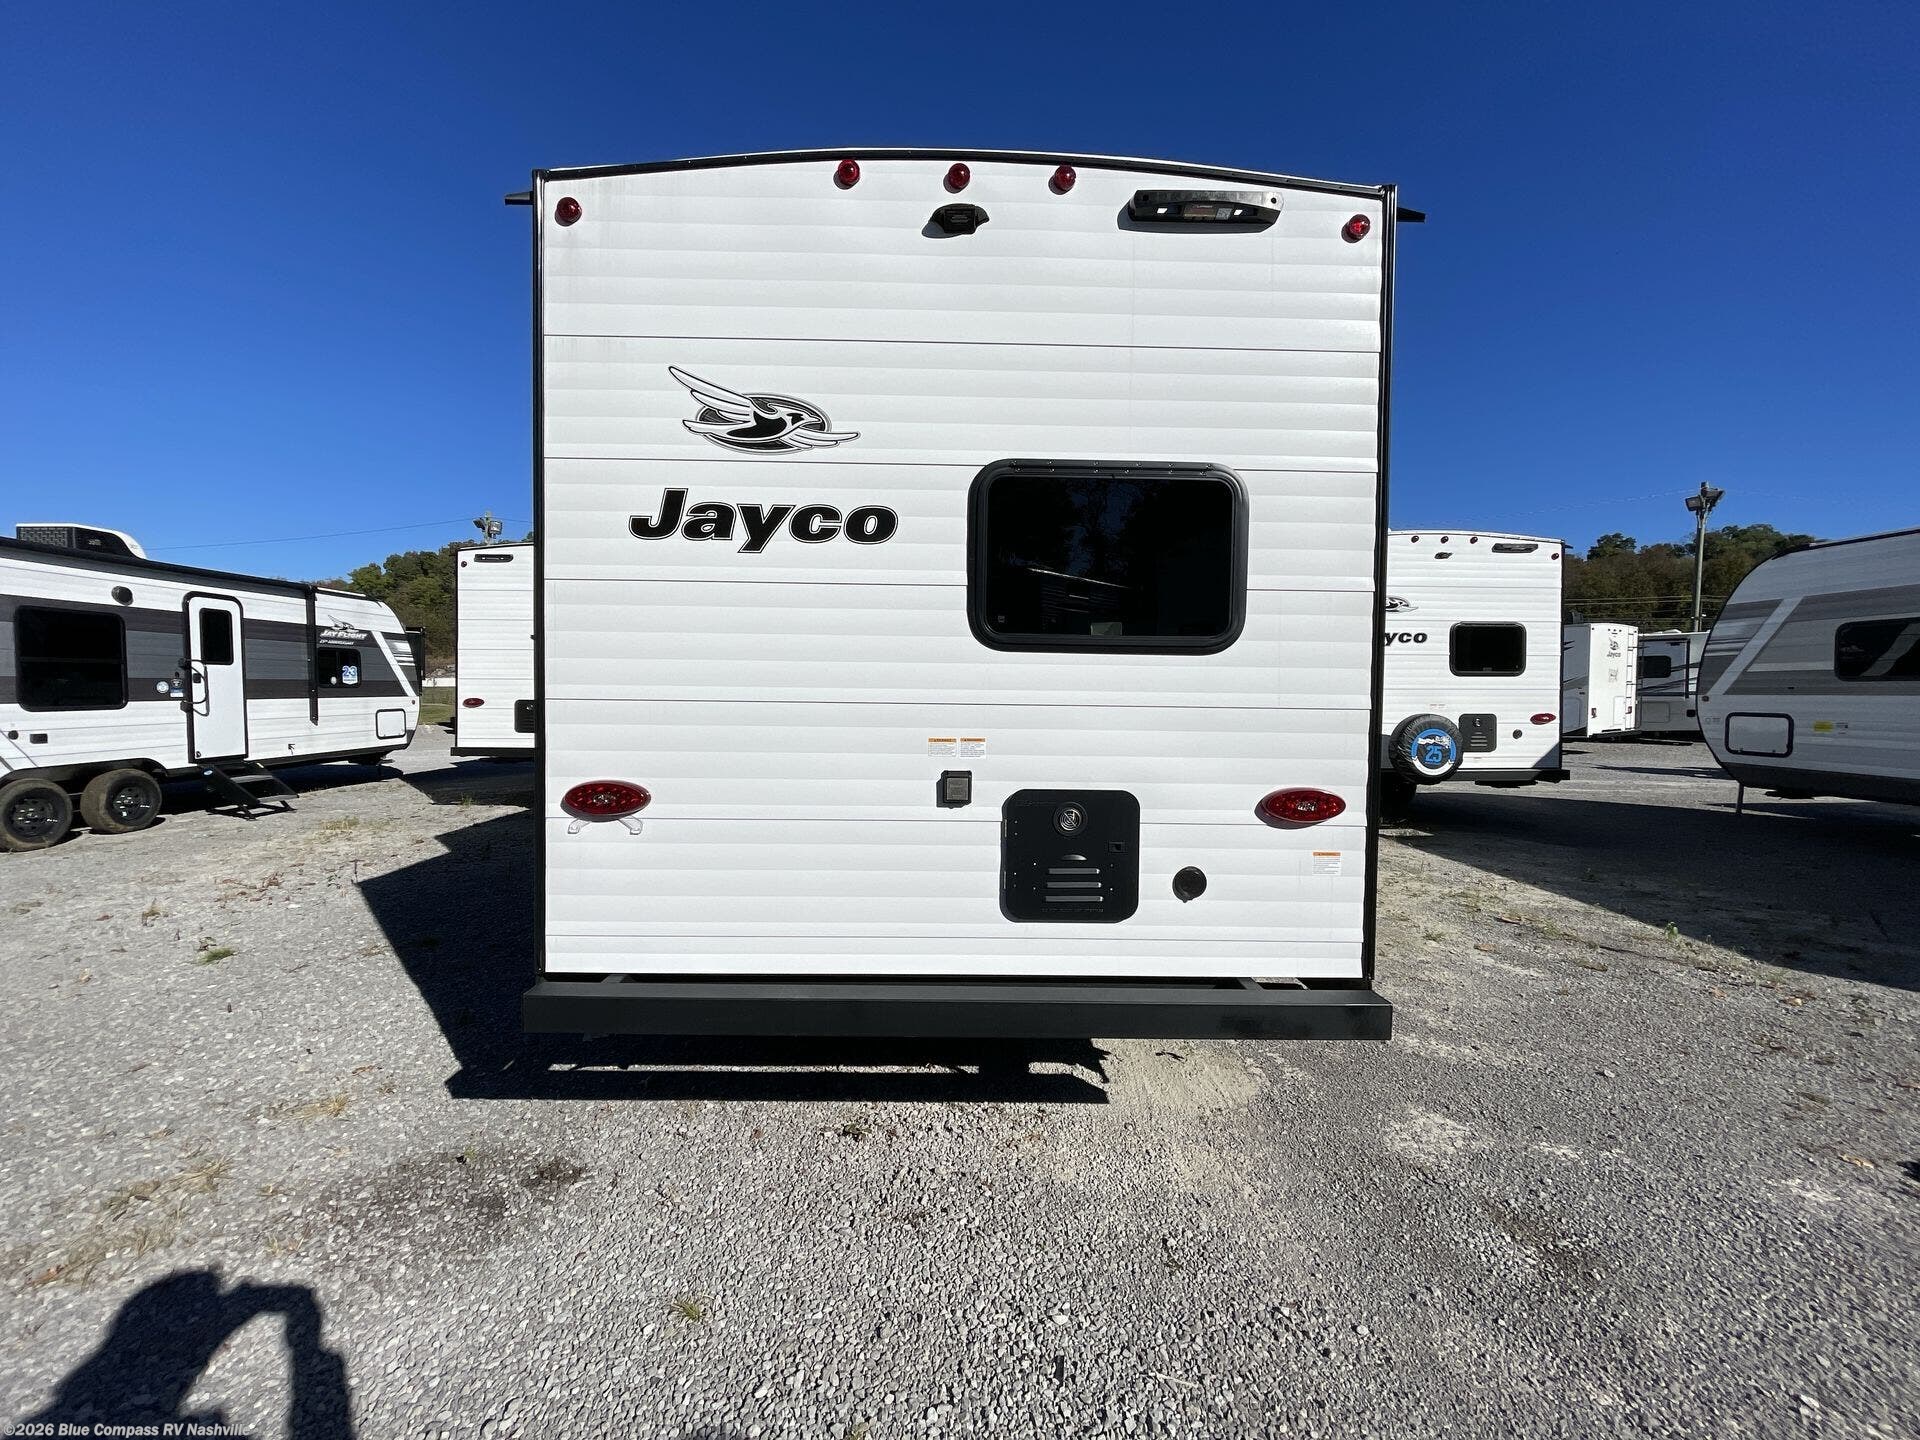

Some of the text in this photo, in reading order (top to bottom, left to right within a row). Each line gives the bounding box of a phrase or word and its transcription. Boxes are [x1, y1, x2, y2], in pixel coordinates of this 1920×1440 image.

[628, 487, 899, 554] Jayco
[1384, 632, 1428, 647] yco
[1424, 745, 1443, 764] 25
